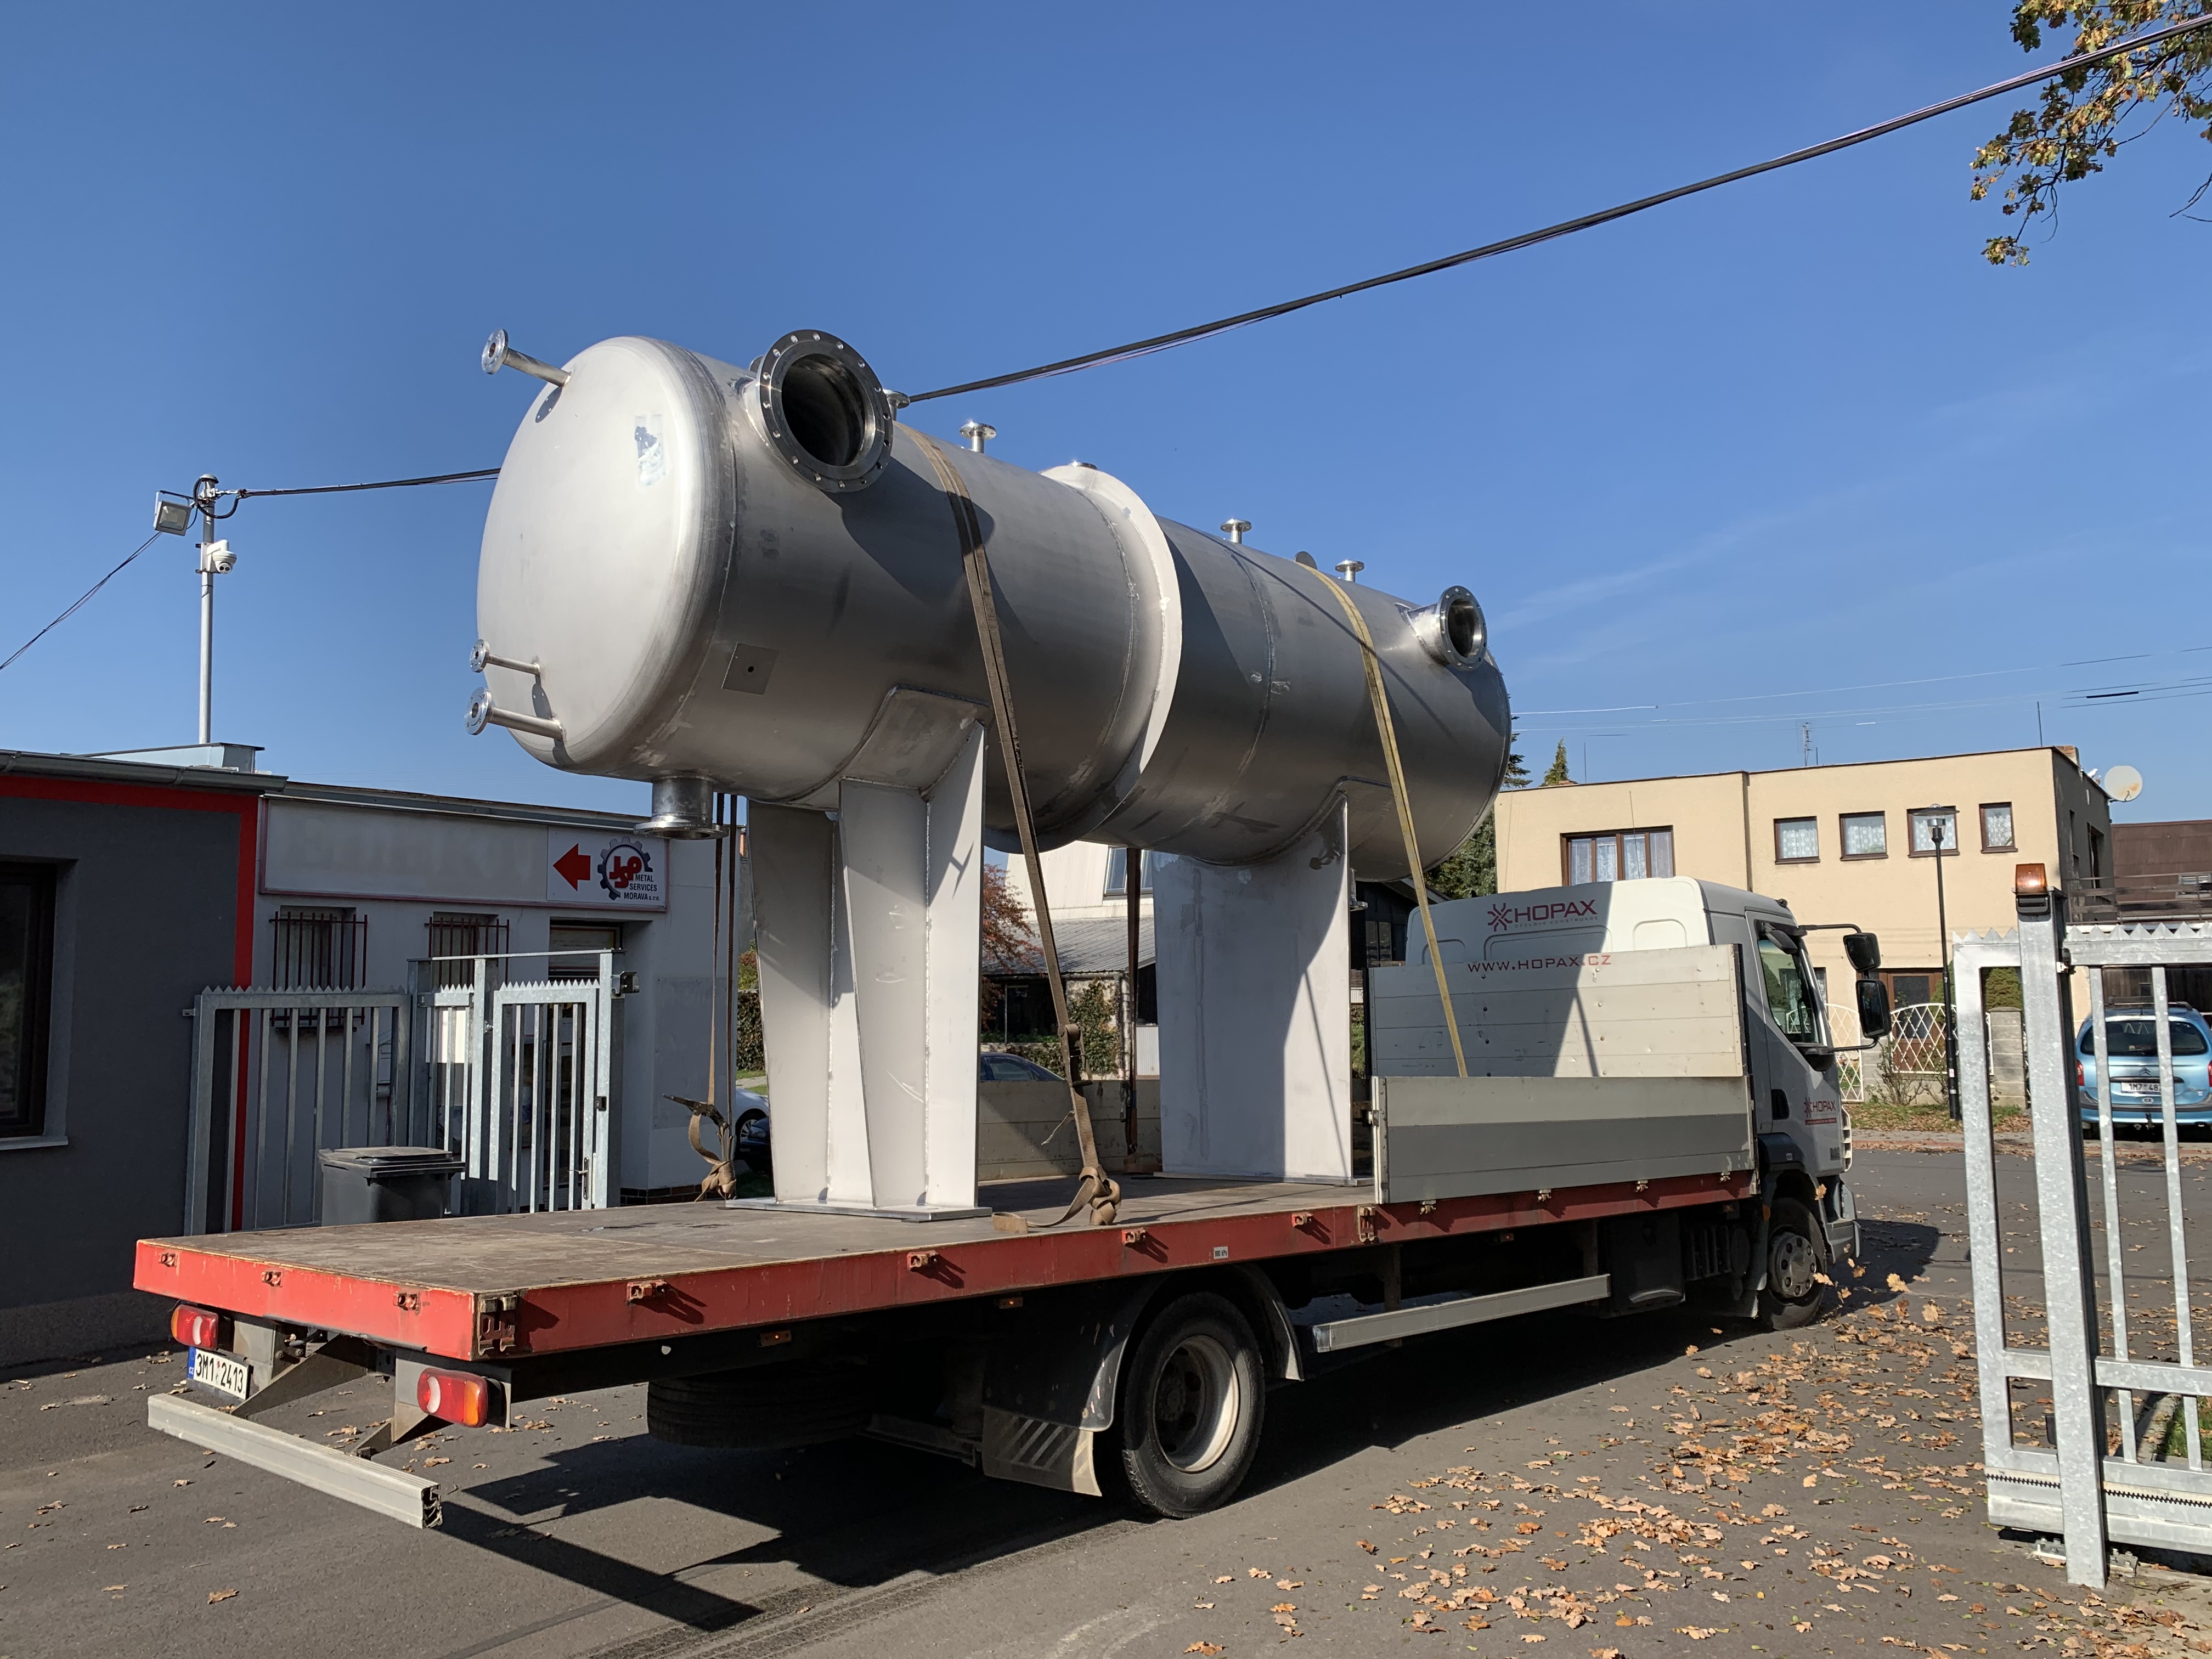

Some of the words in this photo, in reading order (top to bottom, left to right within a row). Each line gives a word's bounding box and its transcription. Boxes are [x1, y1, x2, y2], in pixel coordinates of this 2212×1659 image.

[635, 874, 654, 882] METAL
[629, 883, 657, 891] SERVICES
[624, 892, 648, 900] MORAVA
[1514, 899, 1598, 923] HOPAX
[1468, 955, 1611, 972] WWW.HOPAX.CZ
[1813, 1101, 1836, 1112] HOPAX
[196, 1353, 214, 1382] 3M1
[221, 1362, 244, 1393] 2413
